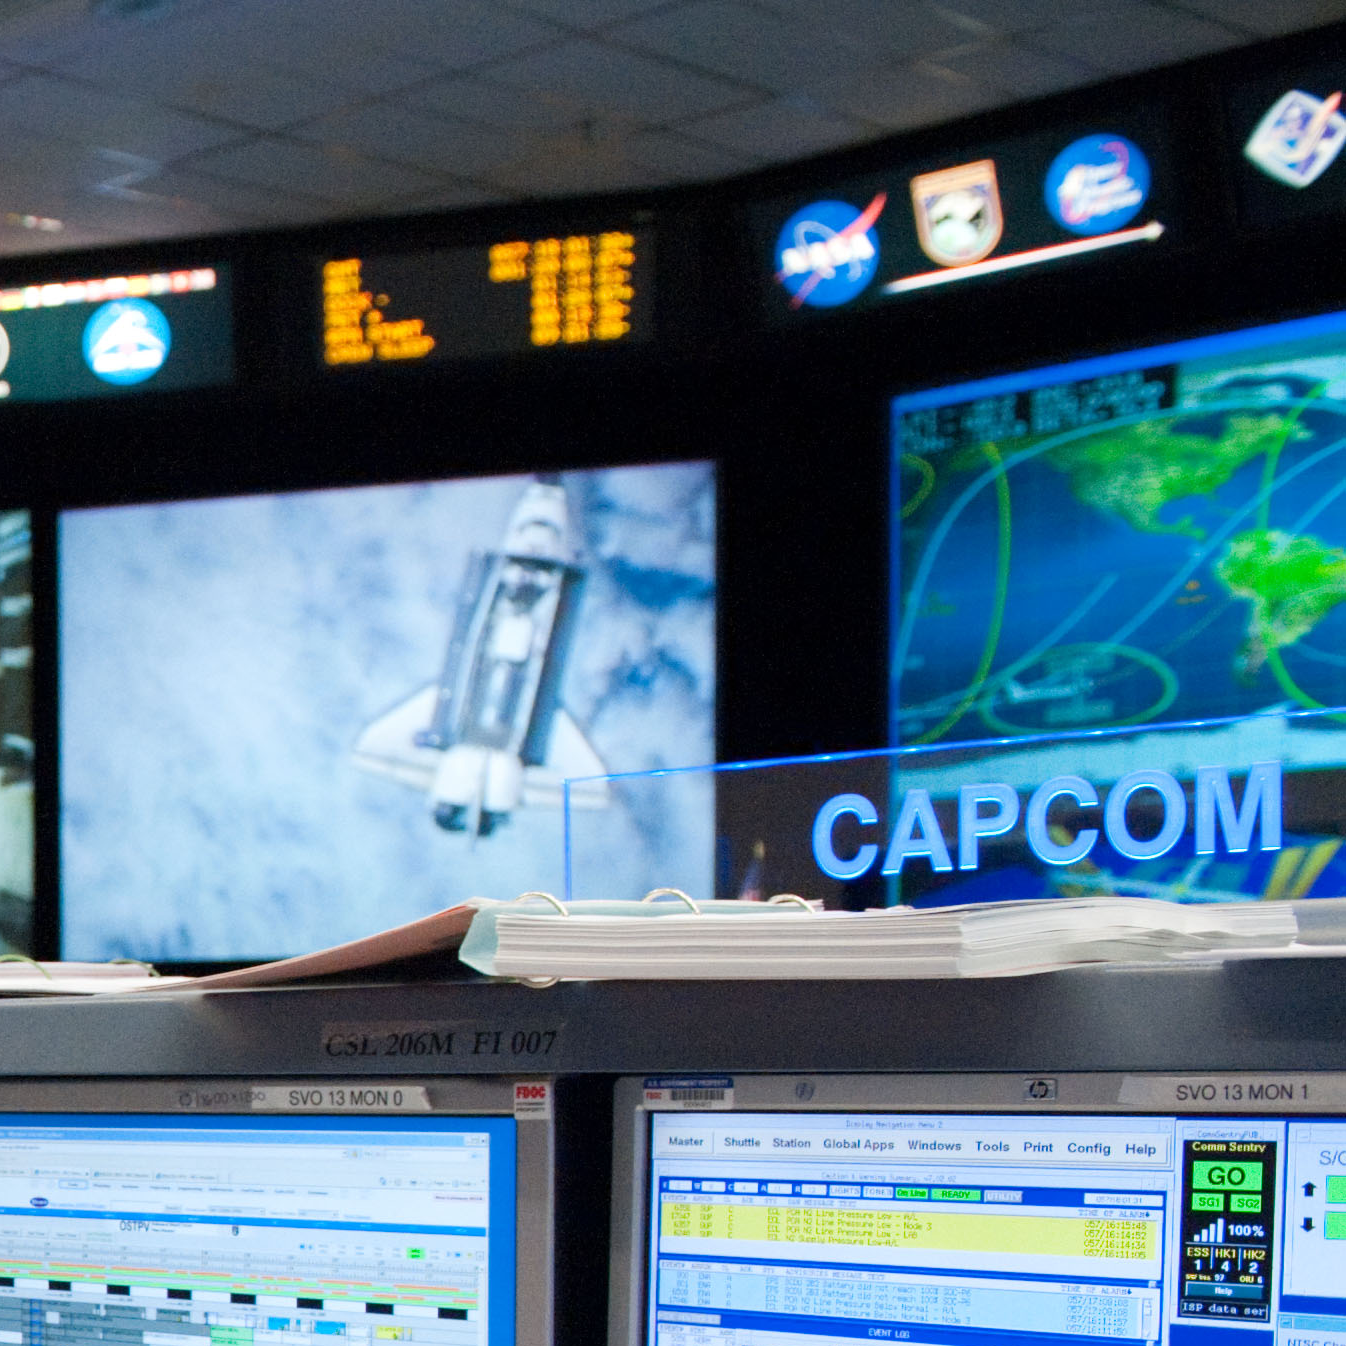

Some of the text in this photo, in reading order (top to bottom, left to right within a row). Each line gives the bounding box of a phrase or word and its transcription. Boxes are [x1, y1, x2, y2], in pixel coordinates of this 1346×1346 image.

[813, 761, 1282, 881] CAPCOM
[326, 1034, 377, 1056] CSL
[385, 1032, 455, 1056] 206M
[511, 1031, 556, 1054] 007
[289, 1090, 324, 1106] SVO
[329, 1090, 346, 1106] 13
[351, 1090, 389, 1106] MON
[516, 1086, 545, 1098] FDOC
[1177, 1084, 1308, 1100] SVO 13 MON 1
[669, 1137, 703, 1146] Master
[724, 1137, 1156, 1156] Shuttle Station Global Apps Windows Tools Print Config Help
[1192, 1142, 1266, 1153] Comm Sentry
[1208, 1167, 1245, 1185] GO
[941, 1190, 970, 1198] READY
[1199, 1197, 1259, 1209] SG1 SG2
[1228, 1225, 1264, 1237] 100%
[1187, 1248, 1265, 1260] ESS HK1 HK2
[1194, 1260, 1257, 1273] 1 4 2
[1209, 1304, 1236, 1313] data
[1244, 1307, 1266, 1315] ser
[869, 1328, 891, 1337] EVENT
